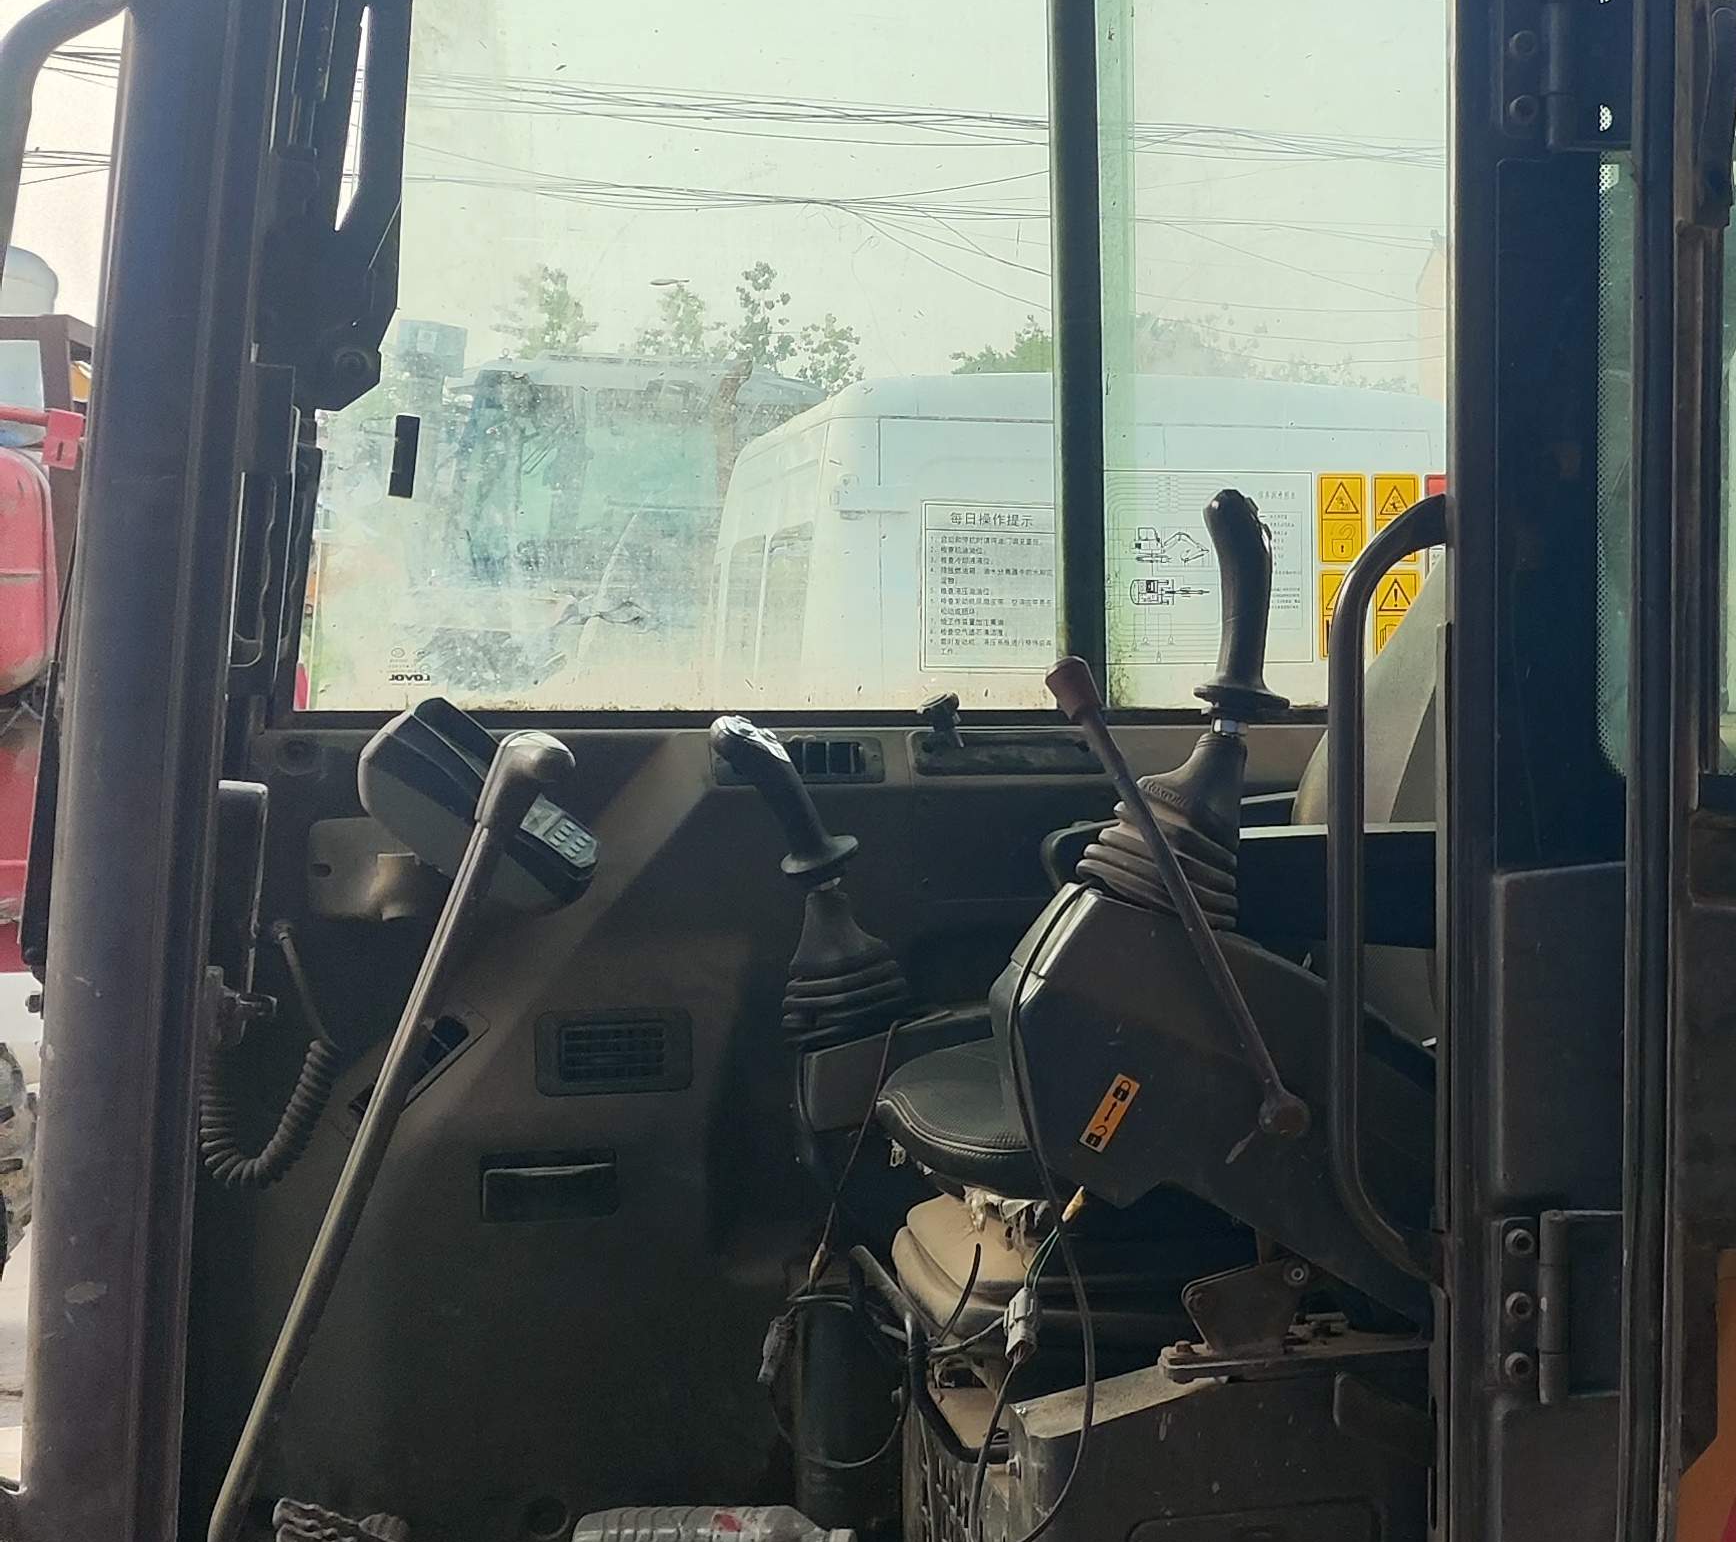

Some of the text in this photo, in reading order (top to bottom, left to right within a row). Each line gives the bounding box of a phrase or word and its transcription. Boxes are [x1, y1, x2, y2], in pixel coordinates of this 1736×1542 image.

[950, 512, 1033, 527] 每日操作提示
